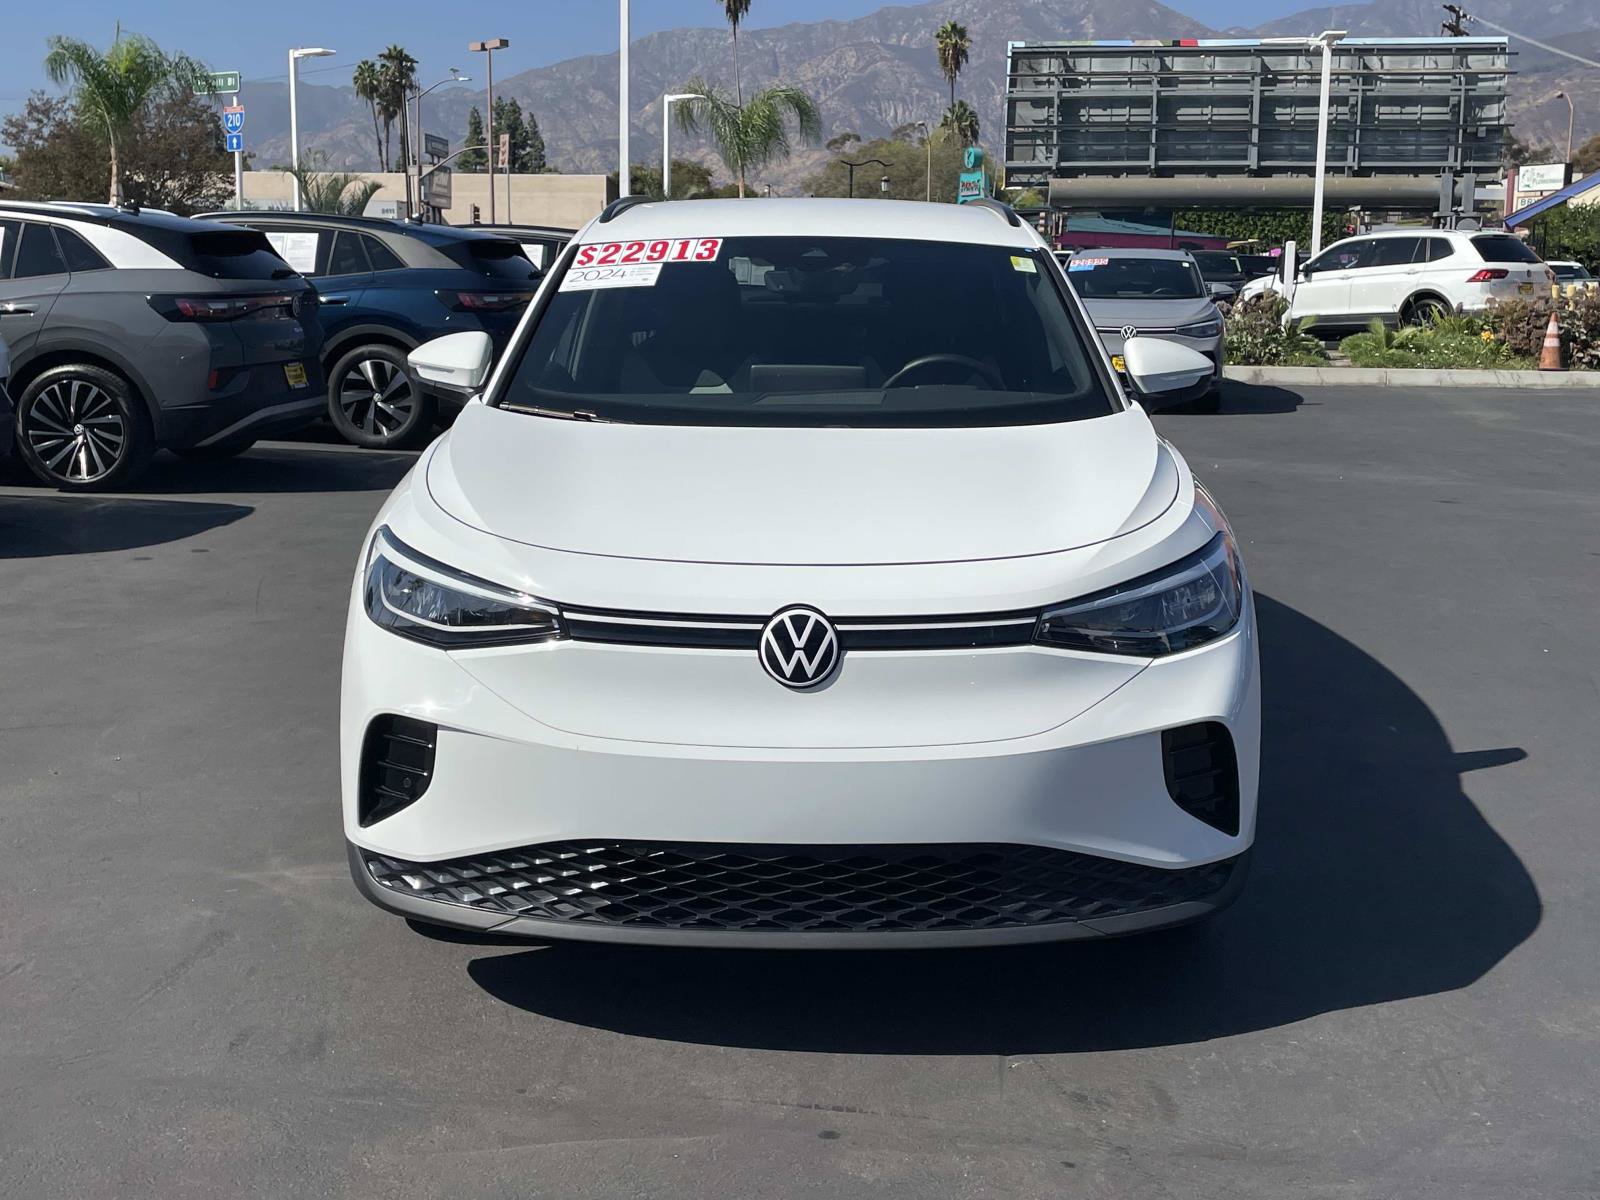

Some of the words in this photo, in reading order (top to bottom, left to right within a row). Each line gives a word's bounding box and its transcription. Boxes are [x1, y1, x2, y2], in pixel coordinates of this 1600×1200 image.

[227, 113, 241, 128] 210
[576, 239, 719, 266] $22913
[569, 268, 626, 283] 2024
[762, 611, 837, 684] VW
